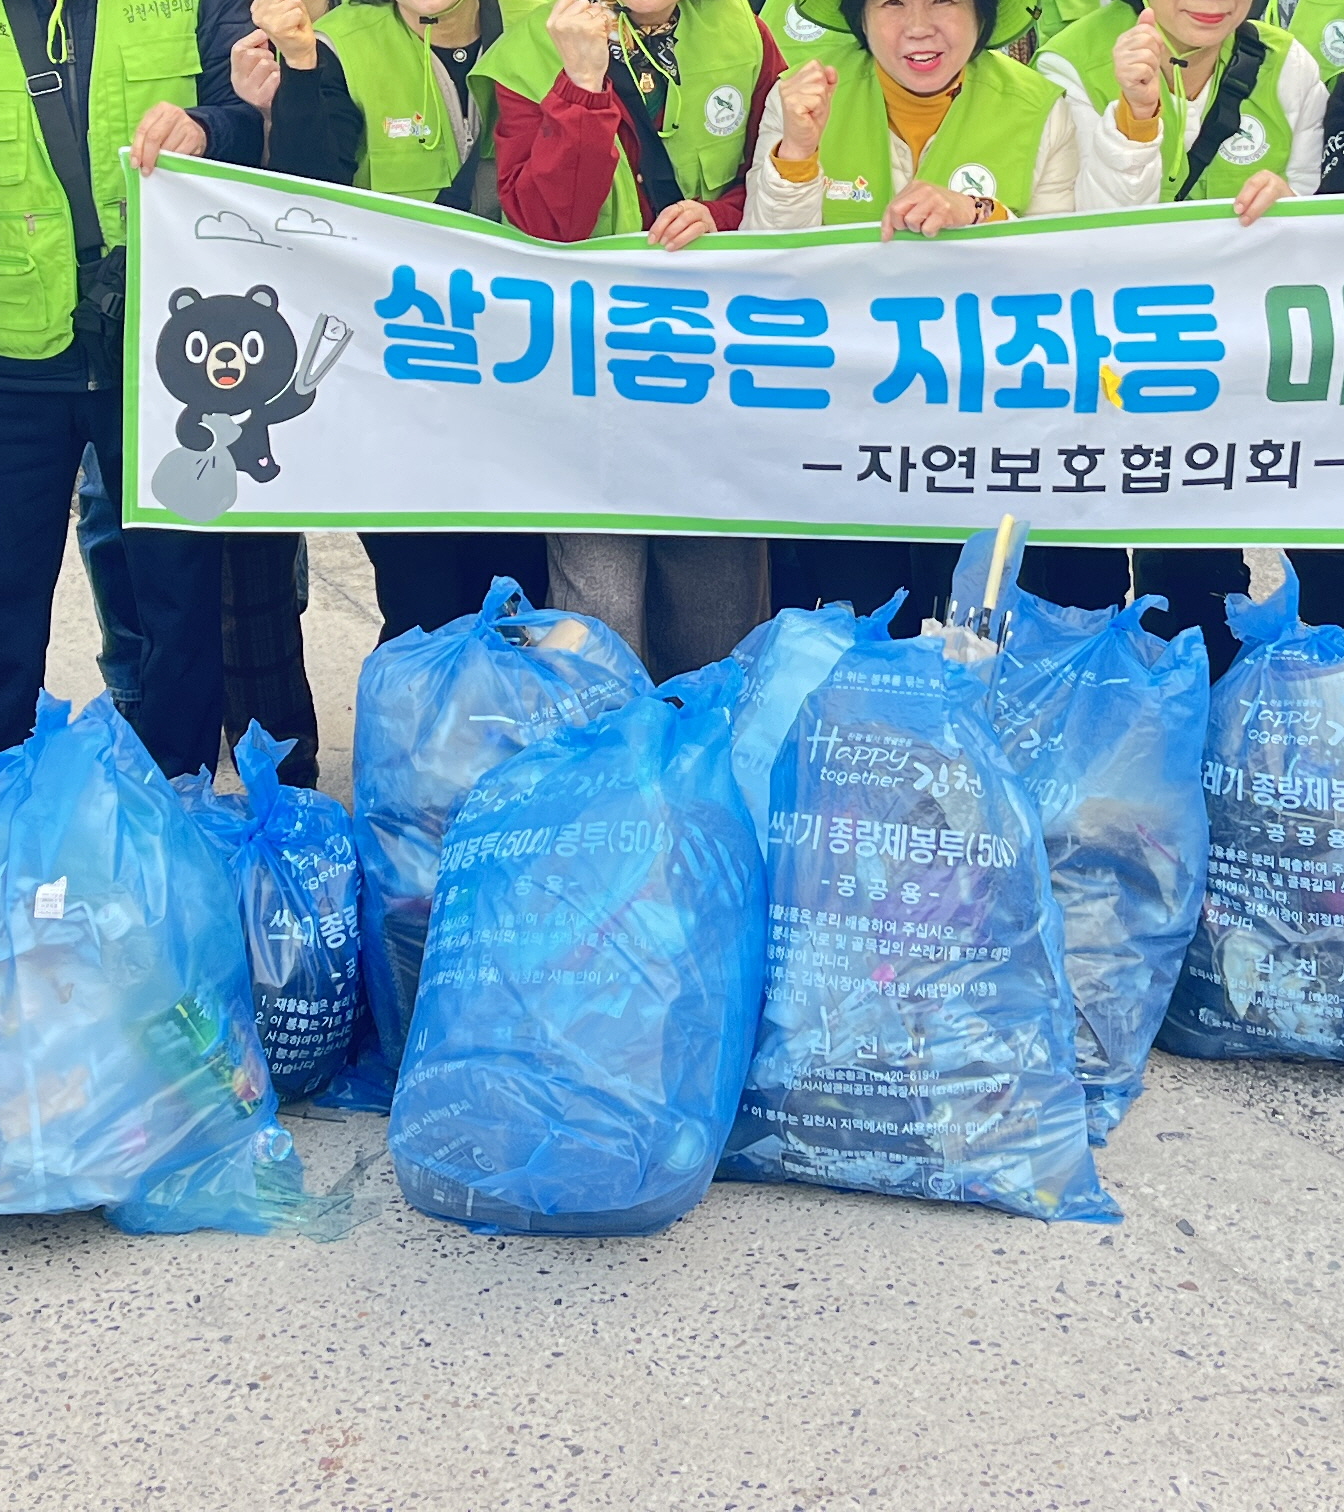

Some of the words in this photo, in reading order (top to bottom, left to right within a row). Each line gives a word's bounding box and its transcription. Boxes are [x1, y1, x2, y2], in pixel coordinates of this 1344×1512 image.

[373, 264, 837, 410] 살기좋은
[870, 282, 1227, 414] 지좌동
[807, 718, 910, 771] Happy
[819, 766, 905, 789] together
[912, 761, 986, 799] 김천
[1202, 760, 1244, 802] 레기
[1251, 852, 1275, 869] 분리
[1278, 857, 1328, 876] 배출하여
[816, 911, 841, 926] 분리
[845, 915, 897, 935] 배출하여
[836, 933, 847, 951] 및
[852, 935, 905, 957] 골목길의
[802, 1113, 837, 1130] 김천시
